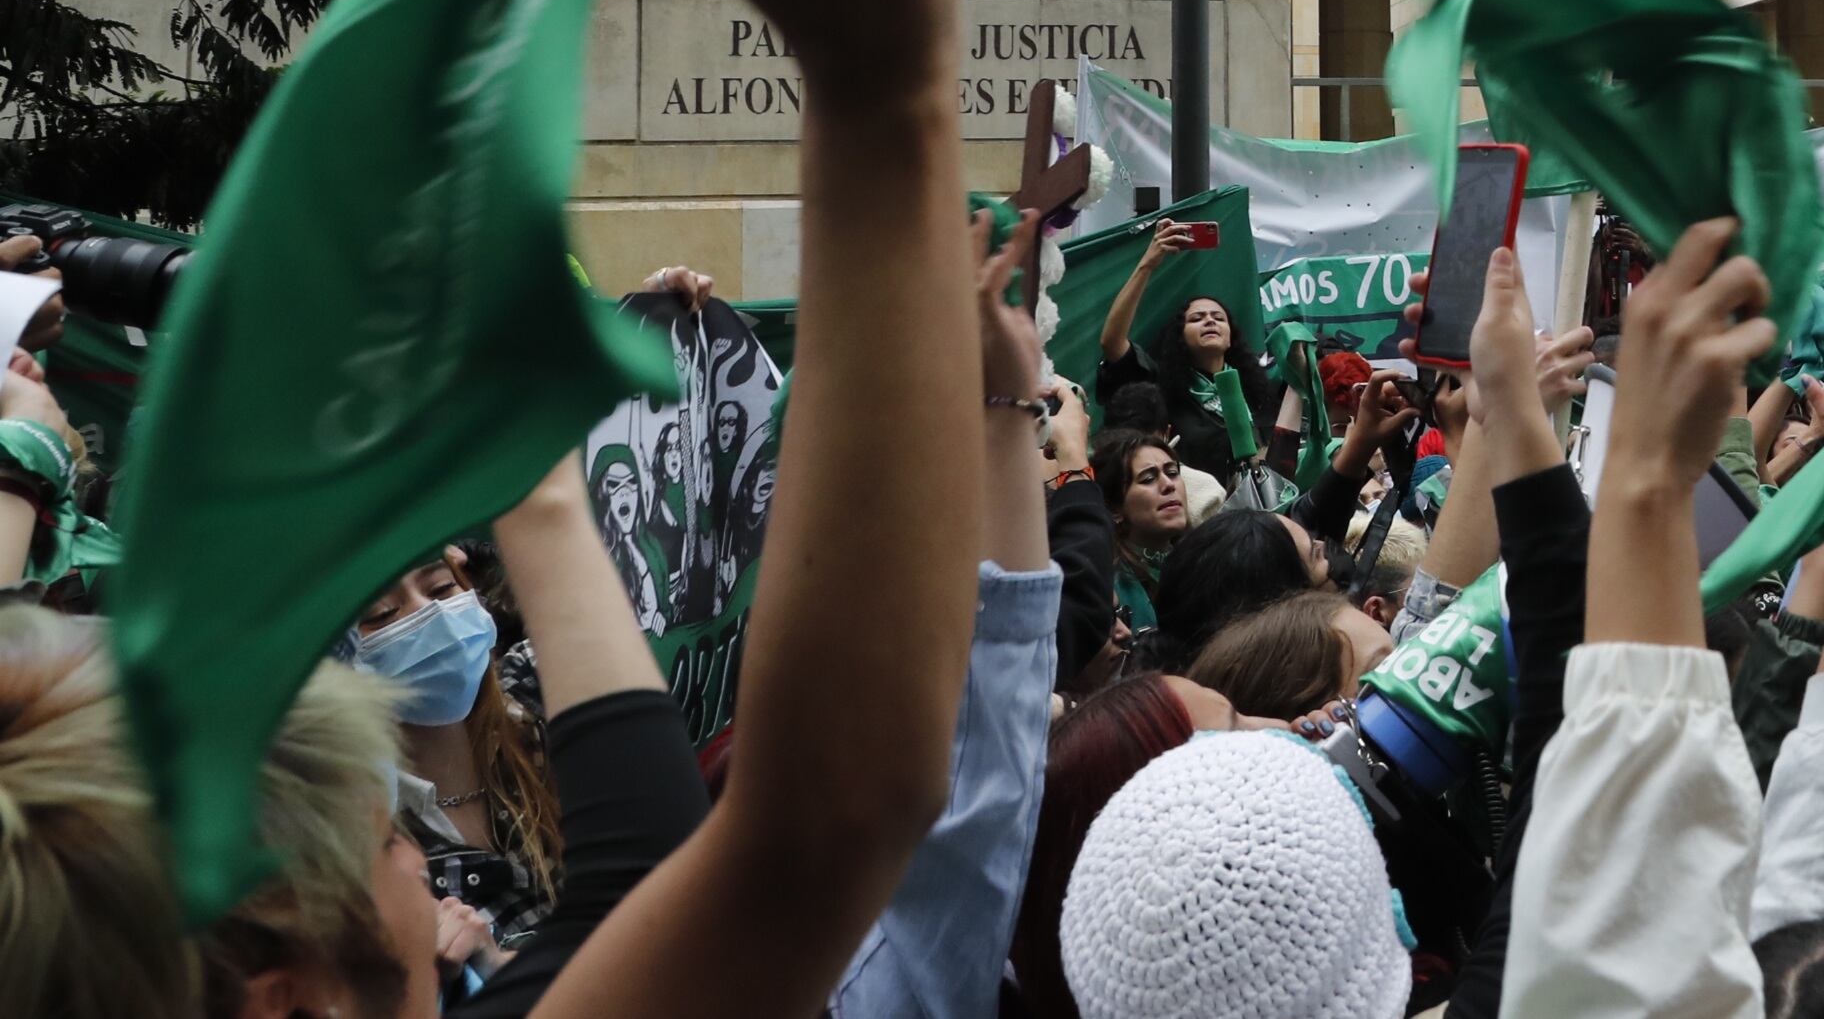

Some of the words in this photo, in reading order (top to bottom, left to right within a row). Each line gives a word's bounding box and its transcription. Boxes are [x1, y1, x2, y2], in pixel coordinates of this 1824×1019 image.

[971, 23, 1146, 61] JUSTICIA
[661, 77, 801, 115] ALFON
[1345, 253, 1412, 308] 70
[1419, 612, 1497, 666] LIB
